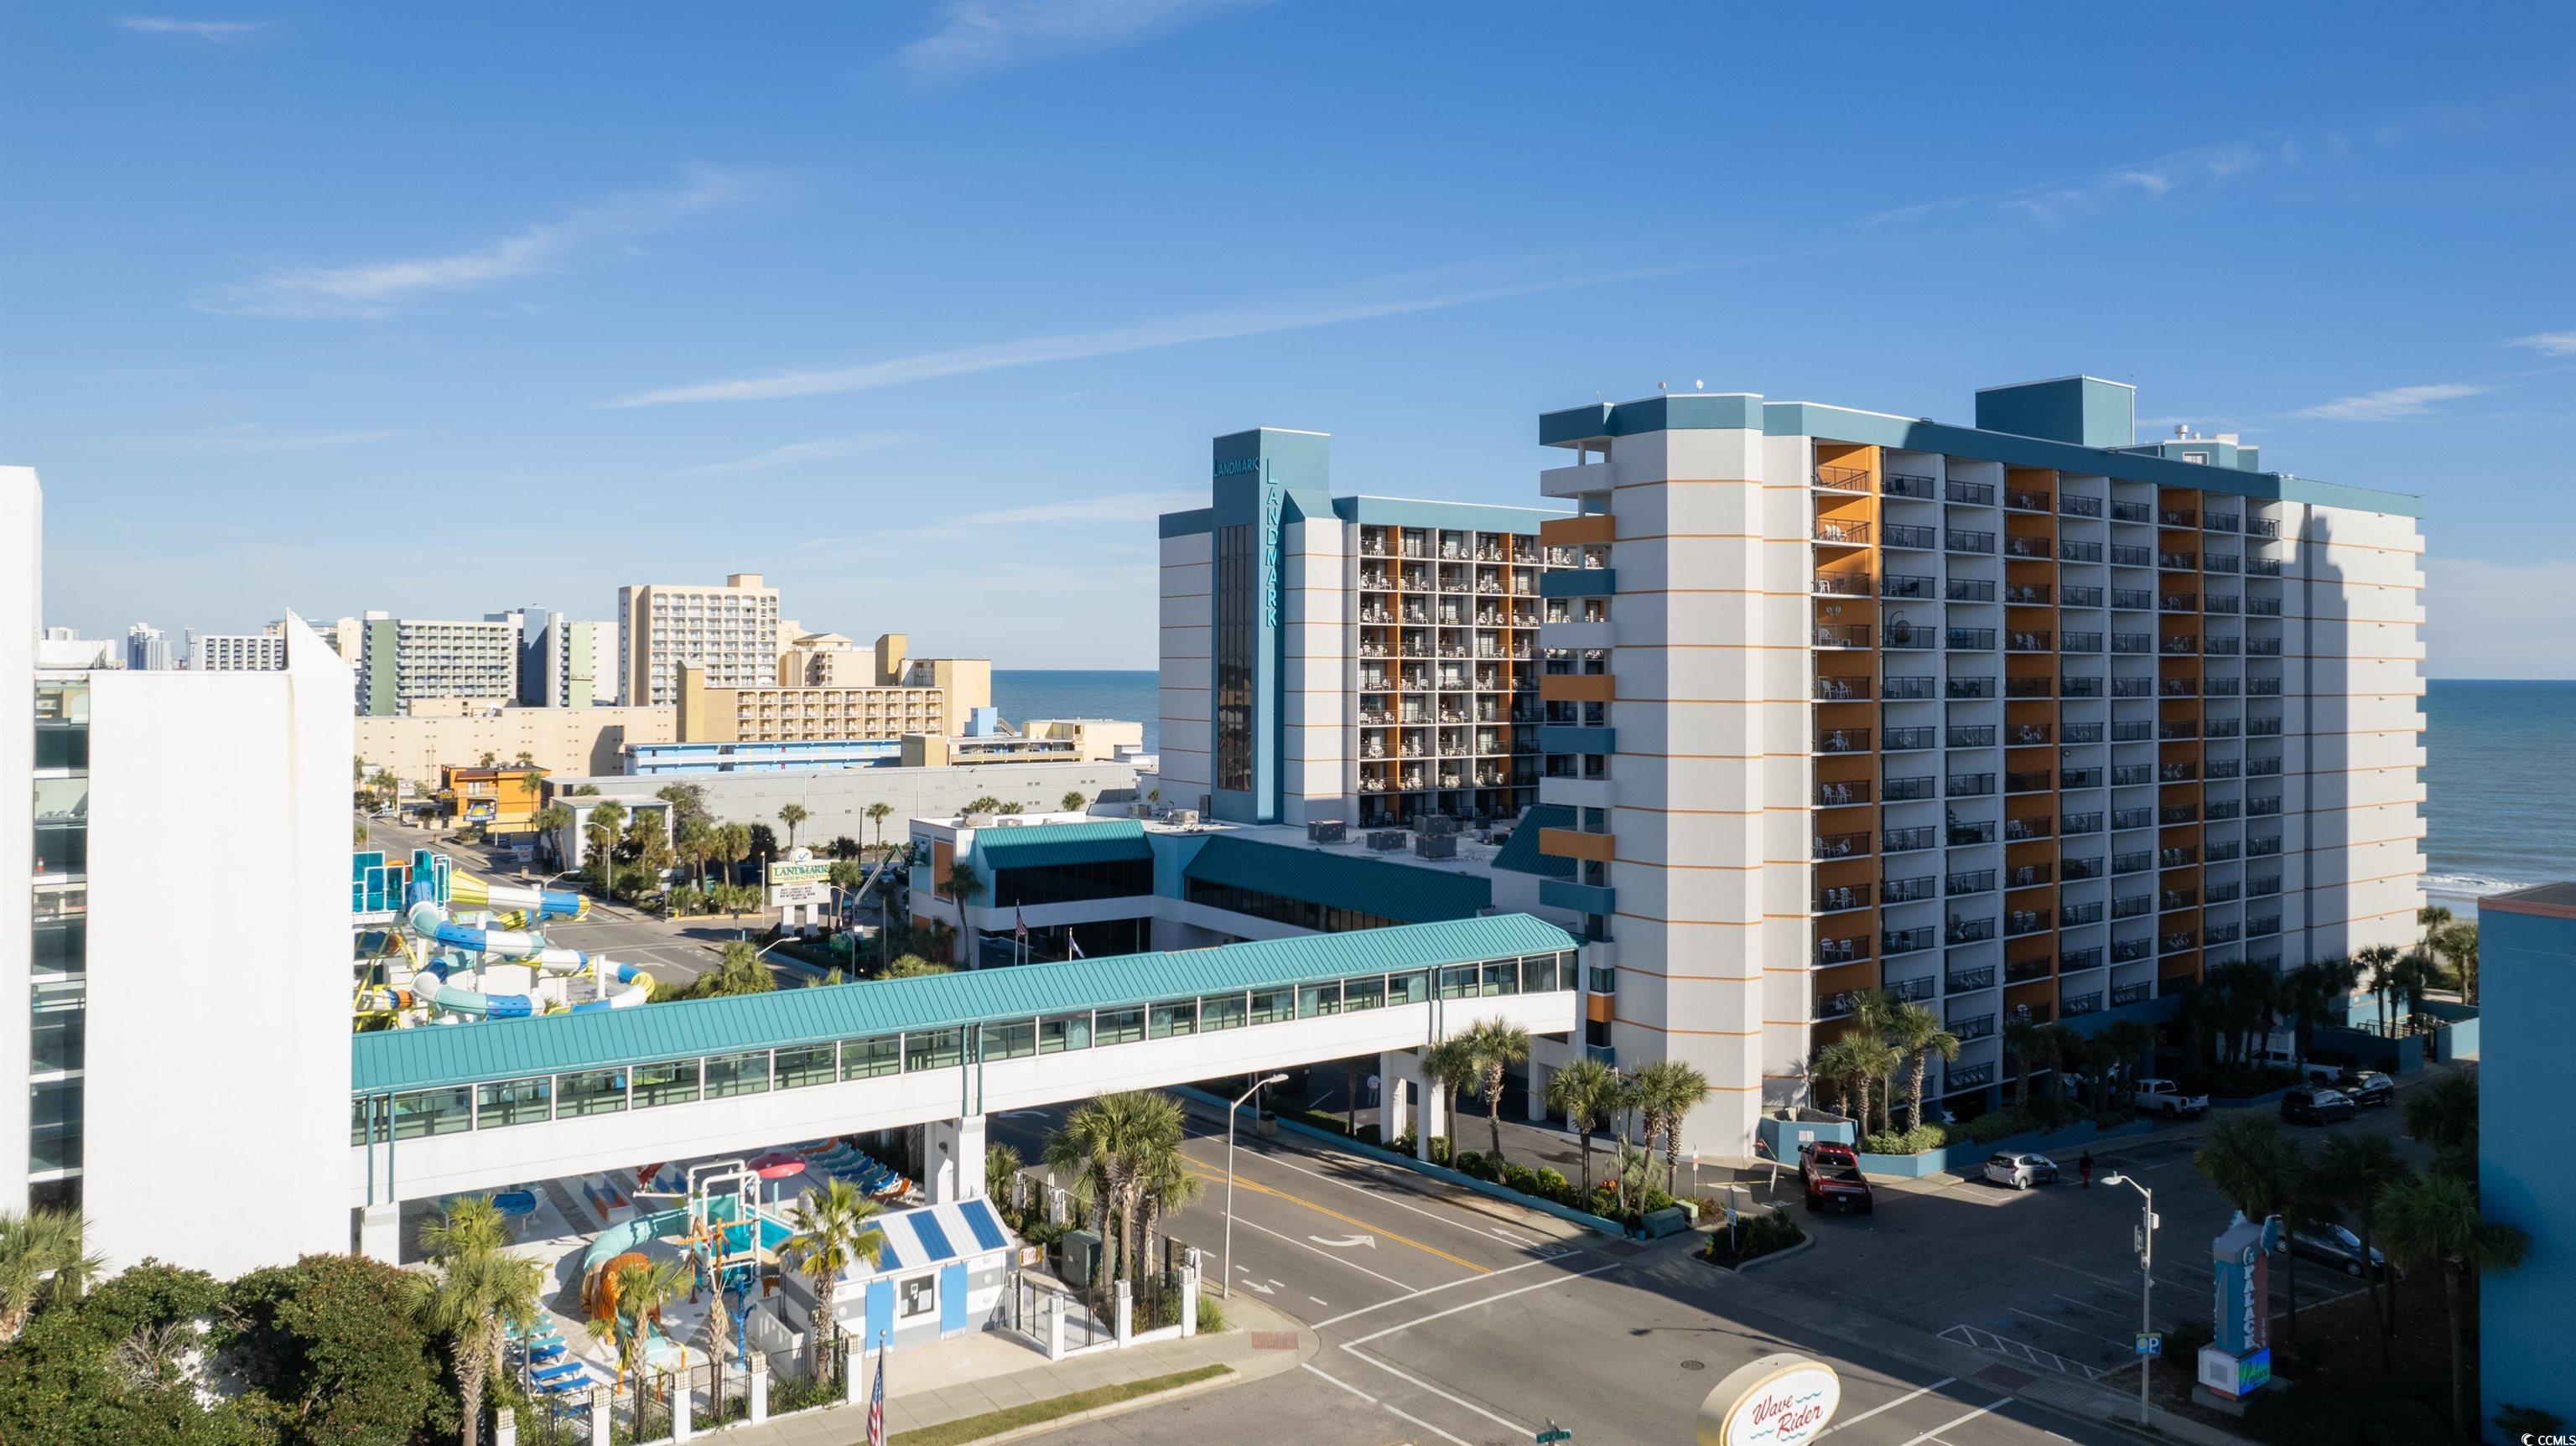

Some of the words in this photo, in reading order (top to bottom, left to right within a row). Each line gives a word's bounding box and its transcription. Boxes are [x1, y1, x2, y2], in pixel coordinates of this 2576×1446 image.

[1213, 456, 1259, 478] LANDMARK
[1266, 459, 1279, 627] LANDMARK
[774, 864, 829, 877] LANDMARK
[1753, 1395, 1794, 1425] Wave
[1777, 1405, 1823, 1438] Rider
